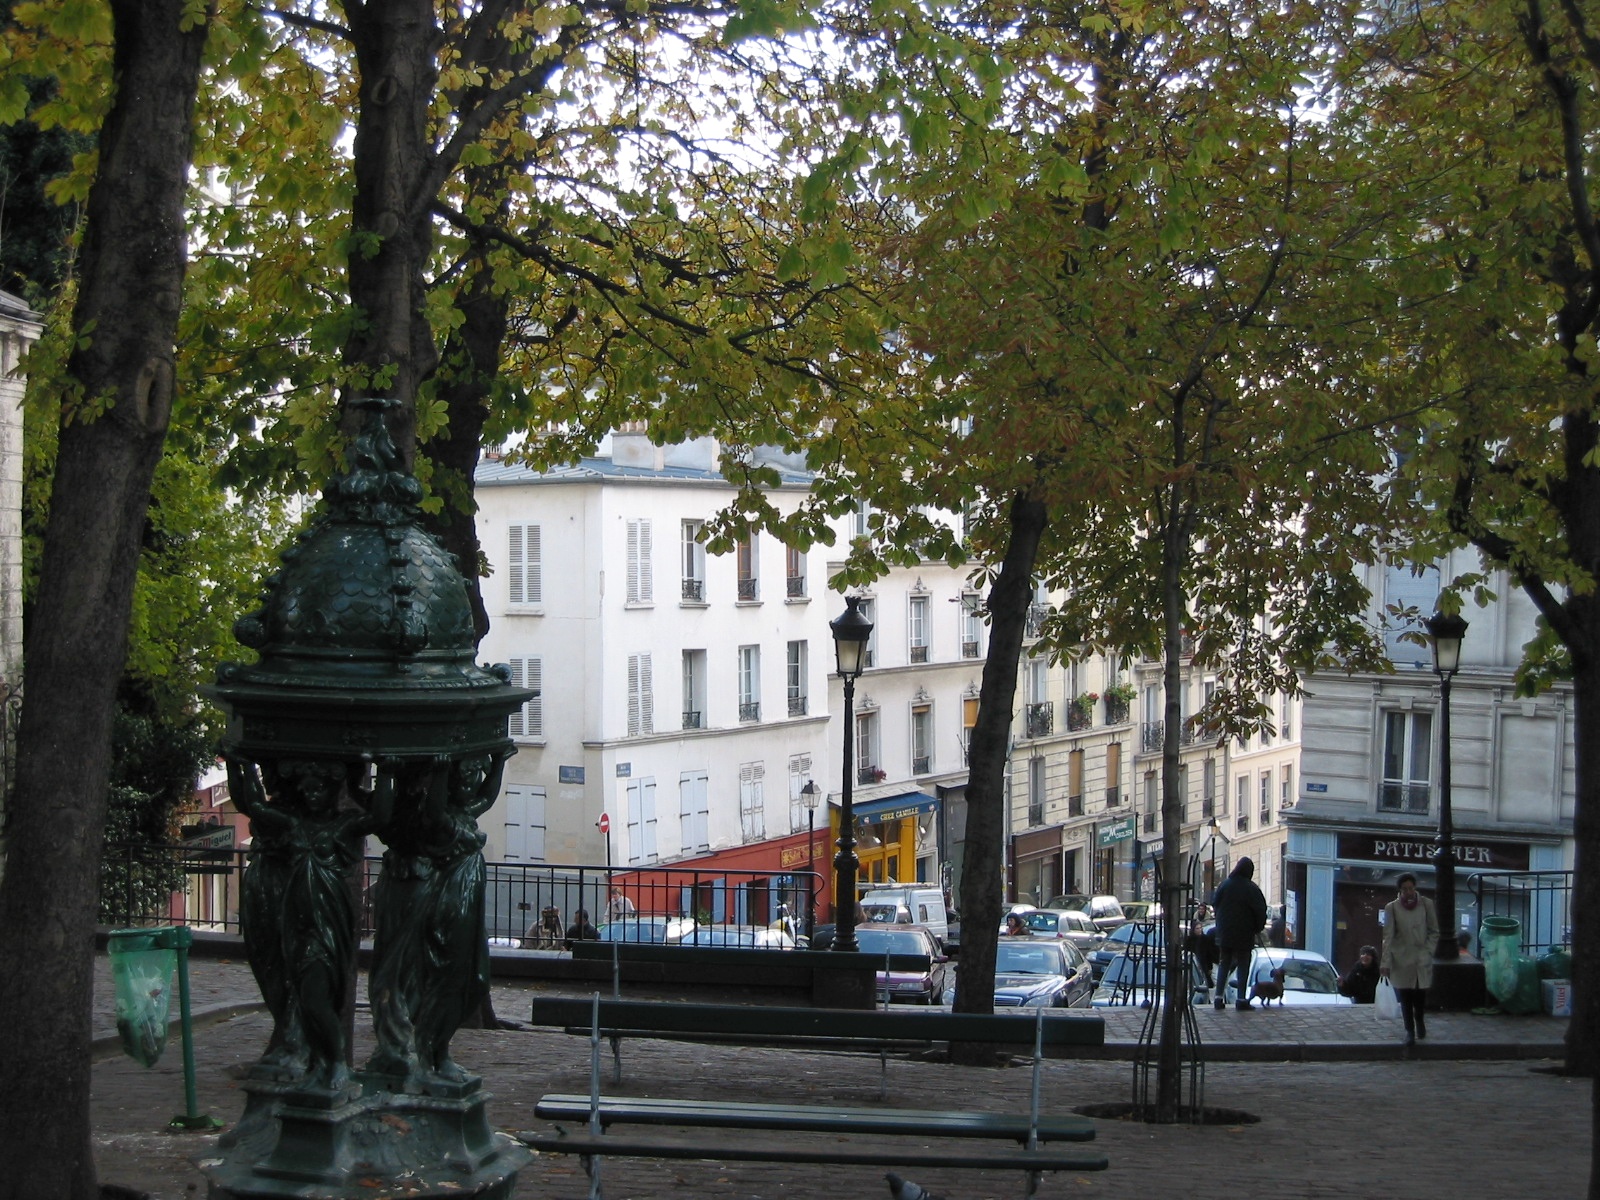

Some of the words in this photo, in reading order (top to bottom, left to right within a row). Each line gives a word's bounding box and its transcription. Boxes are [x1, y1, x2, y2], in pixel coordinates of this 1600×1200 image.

[880, 812, 895, 821] CHEZ
[895, 807, 919, 818] CAMILLE
[1374, 840, 1491, 863] PATISIER
[1556, 987, 1566, 1009] Vittel
